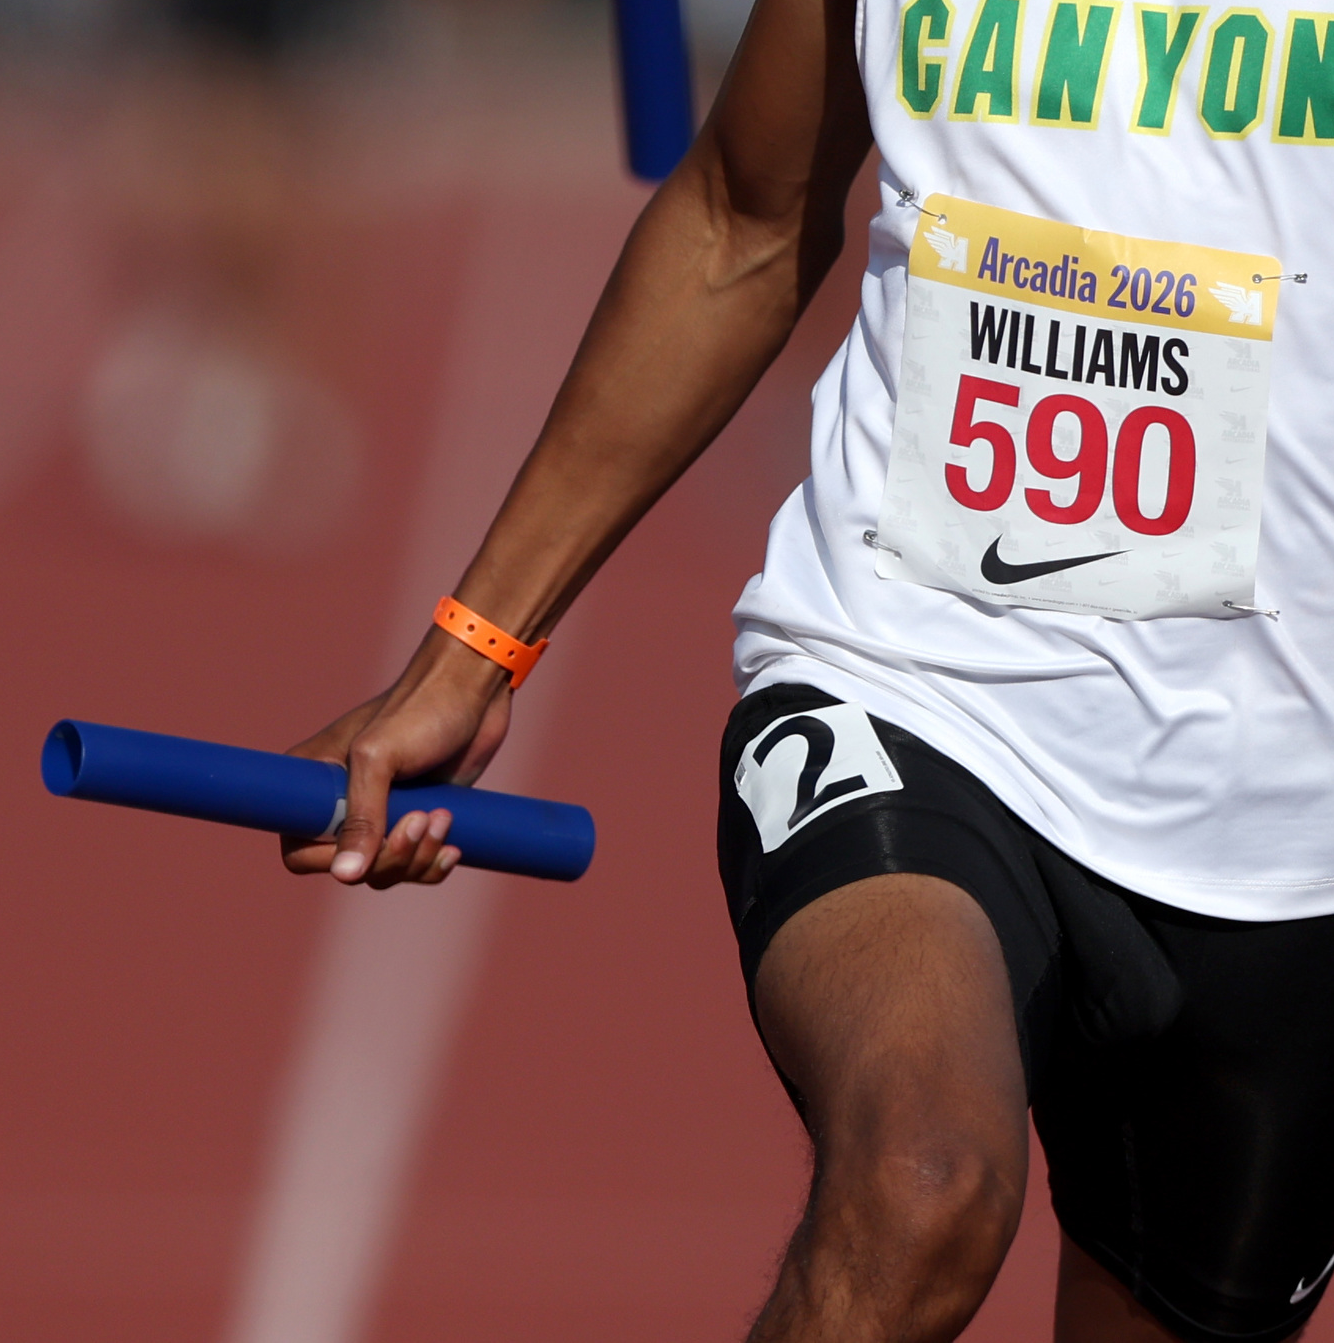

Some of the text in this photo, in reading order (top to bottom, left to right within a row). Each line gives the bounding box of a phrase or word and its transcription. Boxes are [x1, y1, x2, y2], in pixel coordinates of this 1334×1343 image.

[977, 236, 1197, 318] Arcadia 2026
[968, 300, 1191, 397] WILLIAMS
[1227, 357, 1260, 369] ARCADIA
[944, 373, 1197, 537] 590
[1221, 429, 1255, 440] ARCADIA
[1217, 496, 1250, 508] ARCADIA
[752, 714, 868, 832] 2
